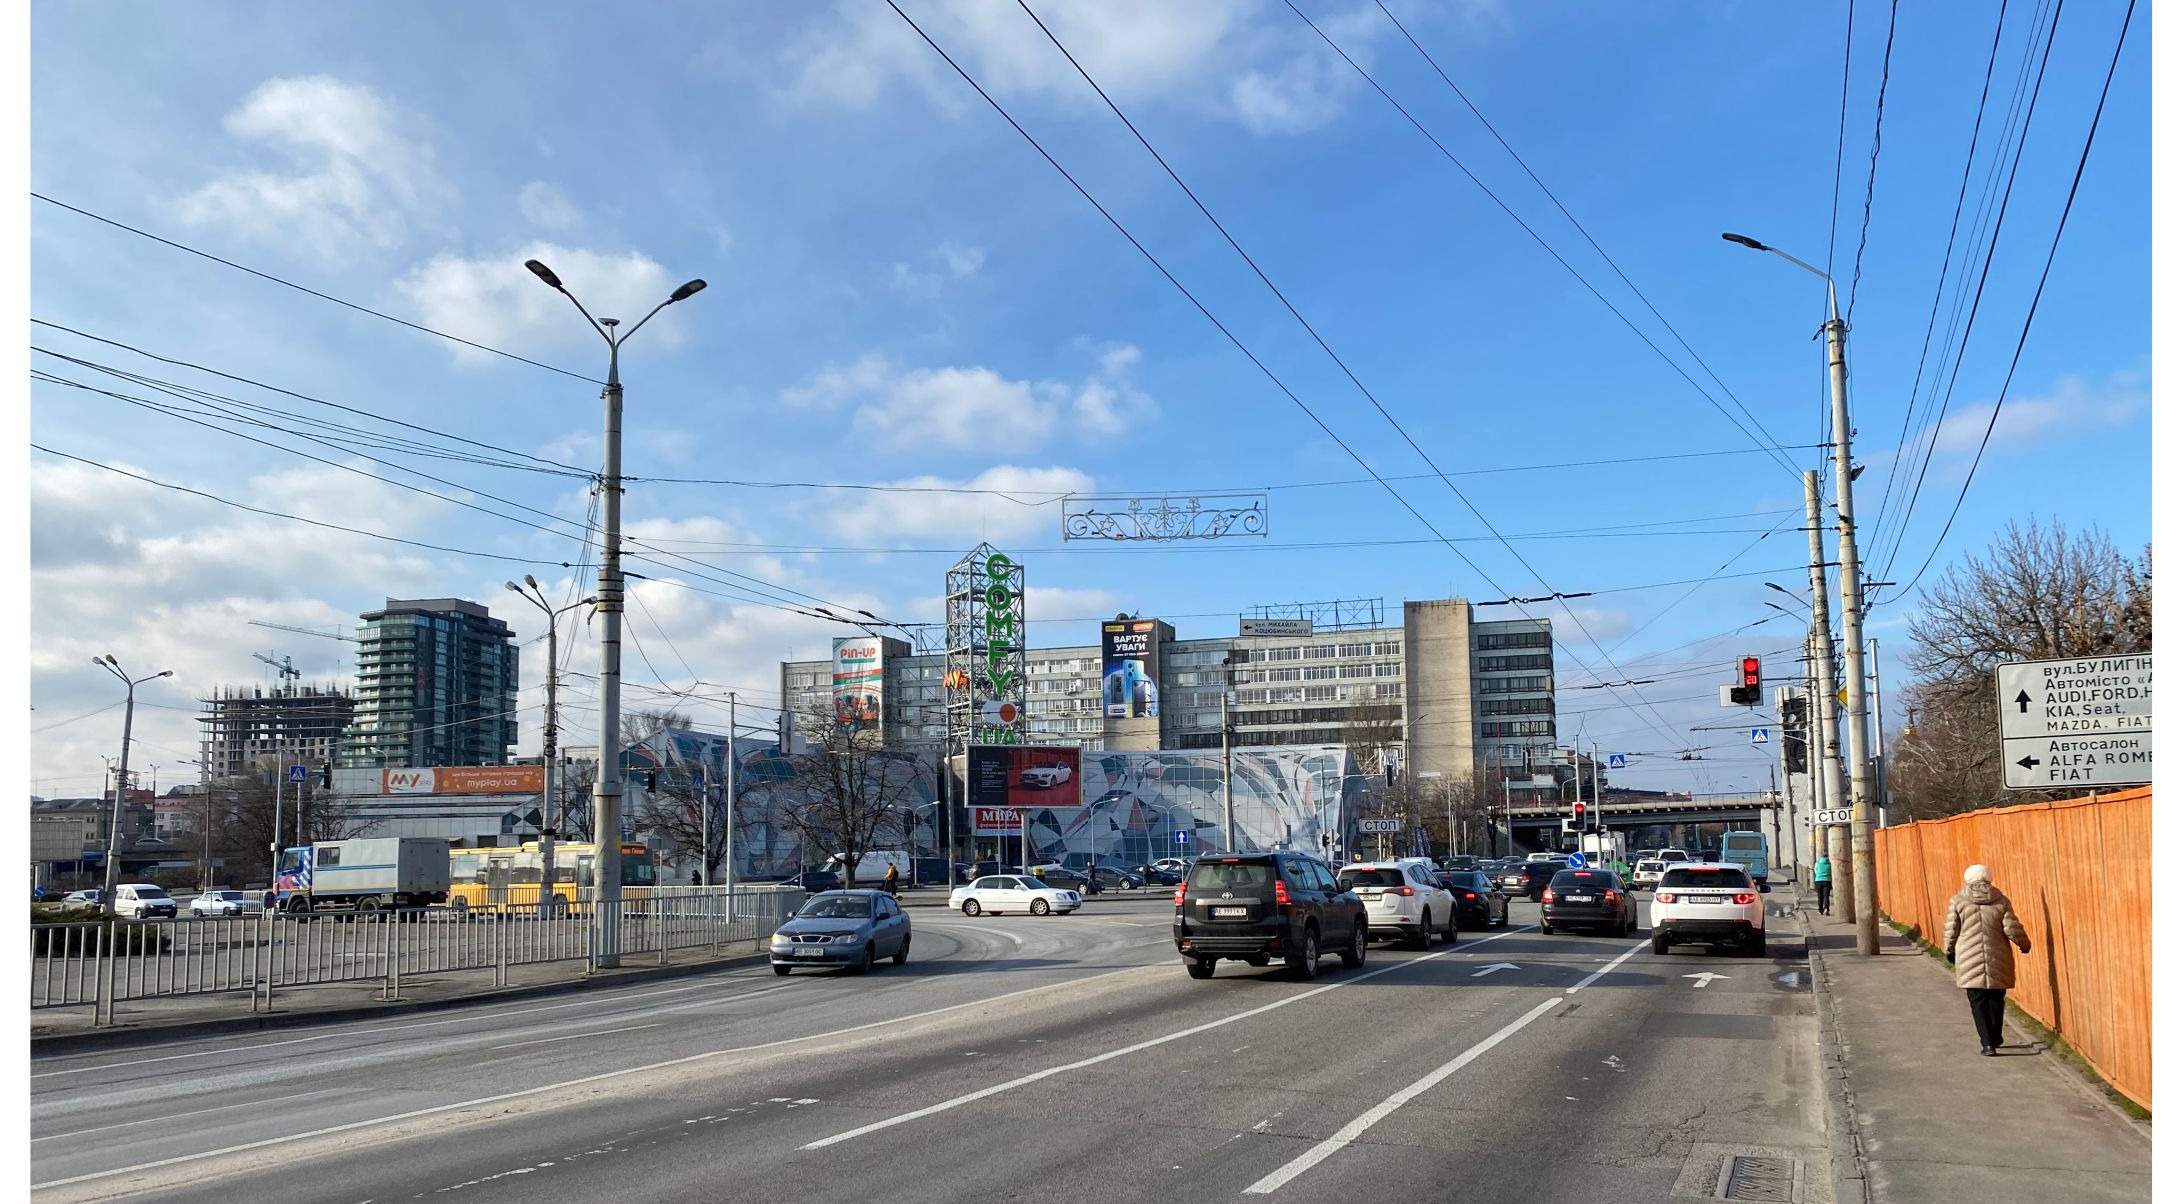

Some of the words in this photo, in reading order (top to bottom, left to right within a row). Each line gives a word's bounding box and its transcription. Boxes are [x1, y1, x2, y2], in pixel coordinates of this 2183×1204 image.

[986, 553, 1013, 695] COMFY
[1113, 634, 1148, 643] ВАРТУЄ
[1115, 643, 1146, 651] УВАГИ
[1746, 675, 1757, 685] 20
[2045, 676, 2131, 690] Автомісто
[2117, 715, 2152, 728] FIAT
[2049, 739, 2138, 752] Автосалон
[2050, 754, 2097, 767] ALFA
[2050, 768, 2094, 781] FIAT
[467, 778, 518, 788] myplay.ua
[982, 810, 1020, 821] МИРА
[1364, 820, 1396, 831] СТОП
